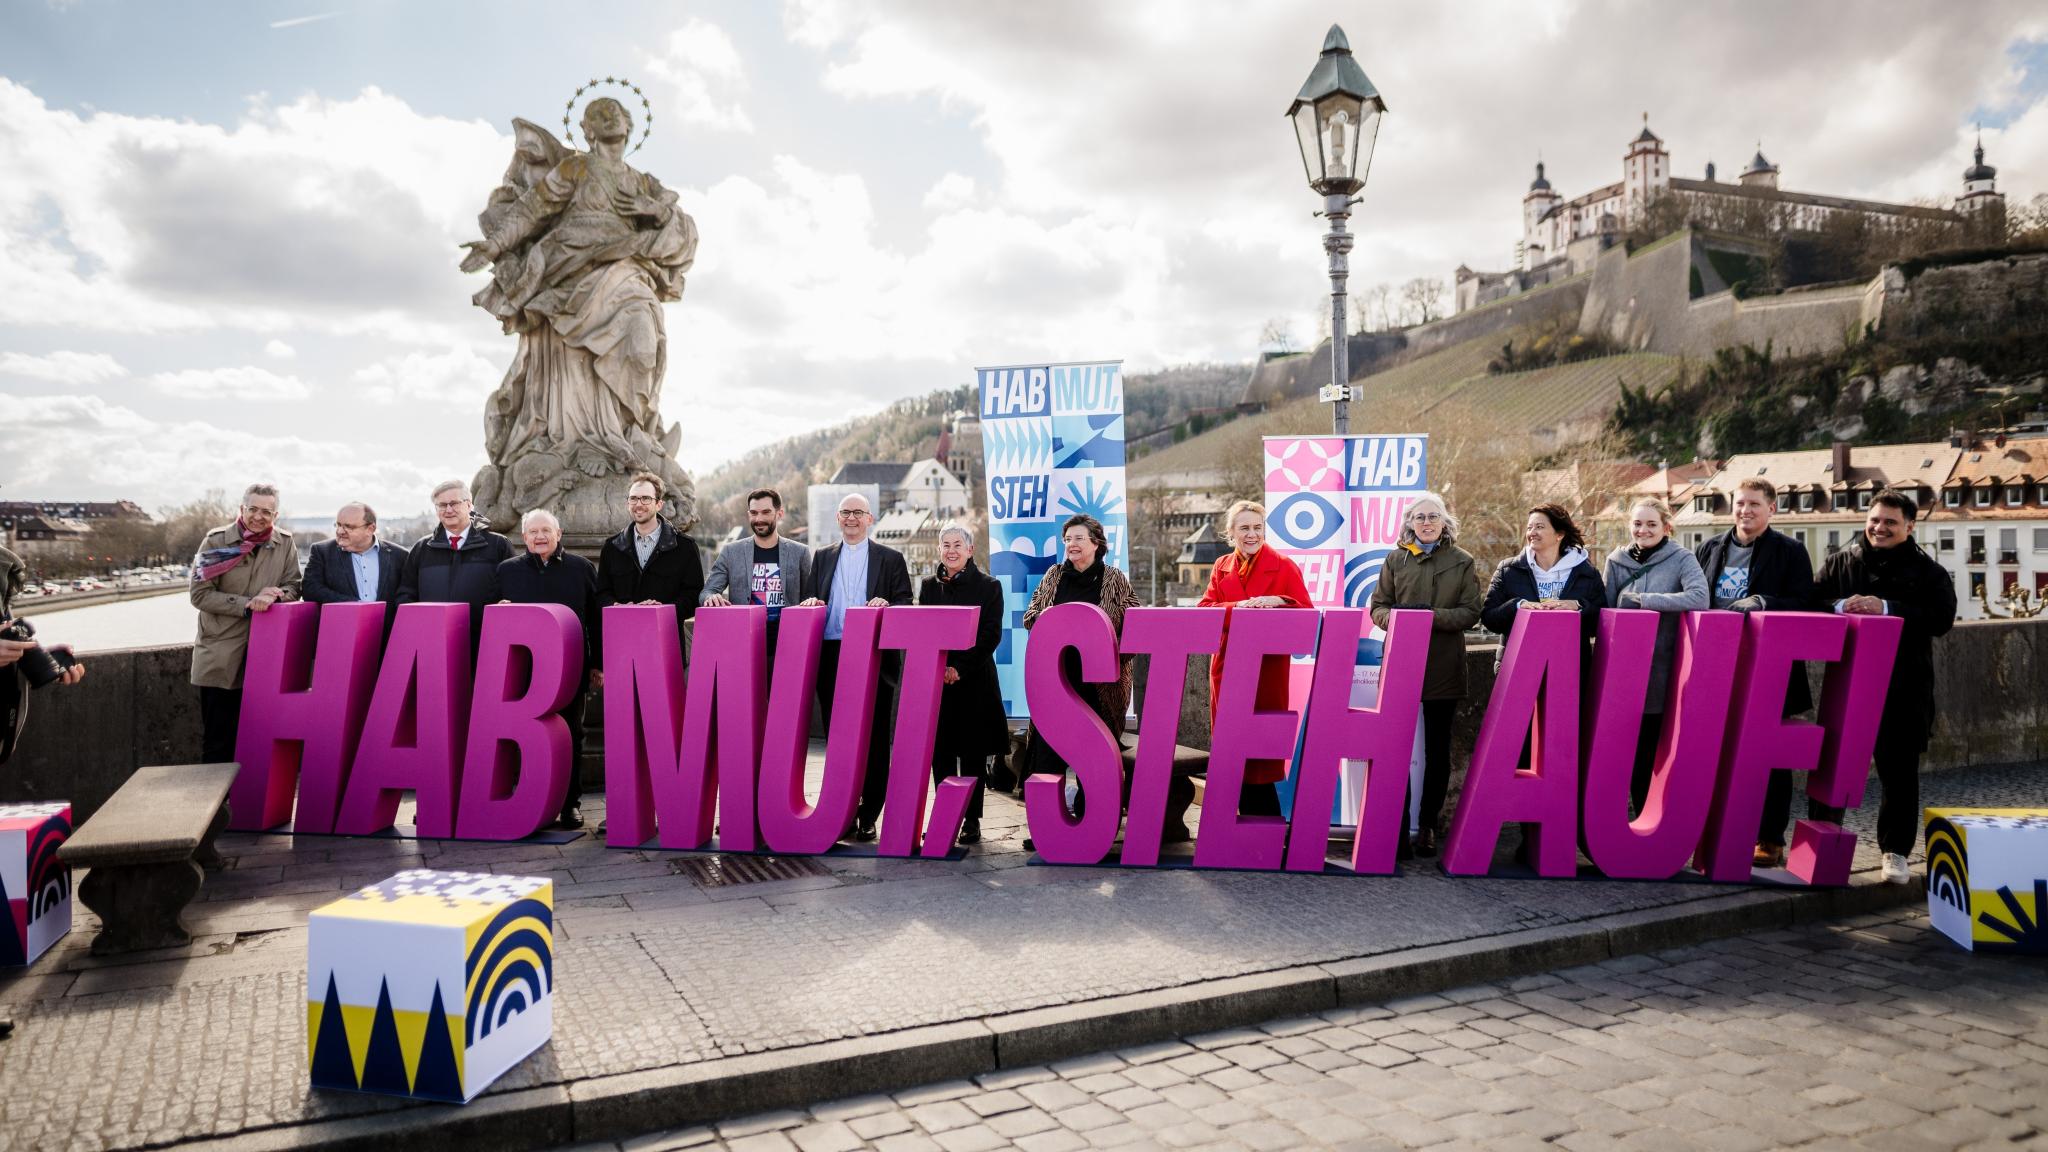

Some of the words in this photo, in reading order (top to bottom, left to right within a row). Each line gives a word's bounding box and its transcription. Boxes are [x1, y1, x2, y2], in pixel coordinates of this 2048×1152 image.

[984, 368, 1047, 416] HAB
[1054, 365, 1120, 412] MUT,
[1348, 438, 1423, 487] HAB
[990, 474, 1050, 520] STEH
[1350, 497, 1415, 545] MU
[753, 564, 765, 576] AB
[229, 601, 584, 841] HAB
[602, 603, 981, 858] MUT,
[1024, 601, 1434, 873] STEH
[1440, 607, 1904, 886] AUF!
